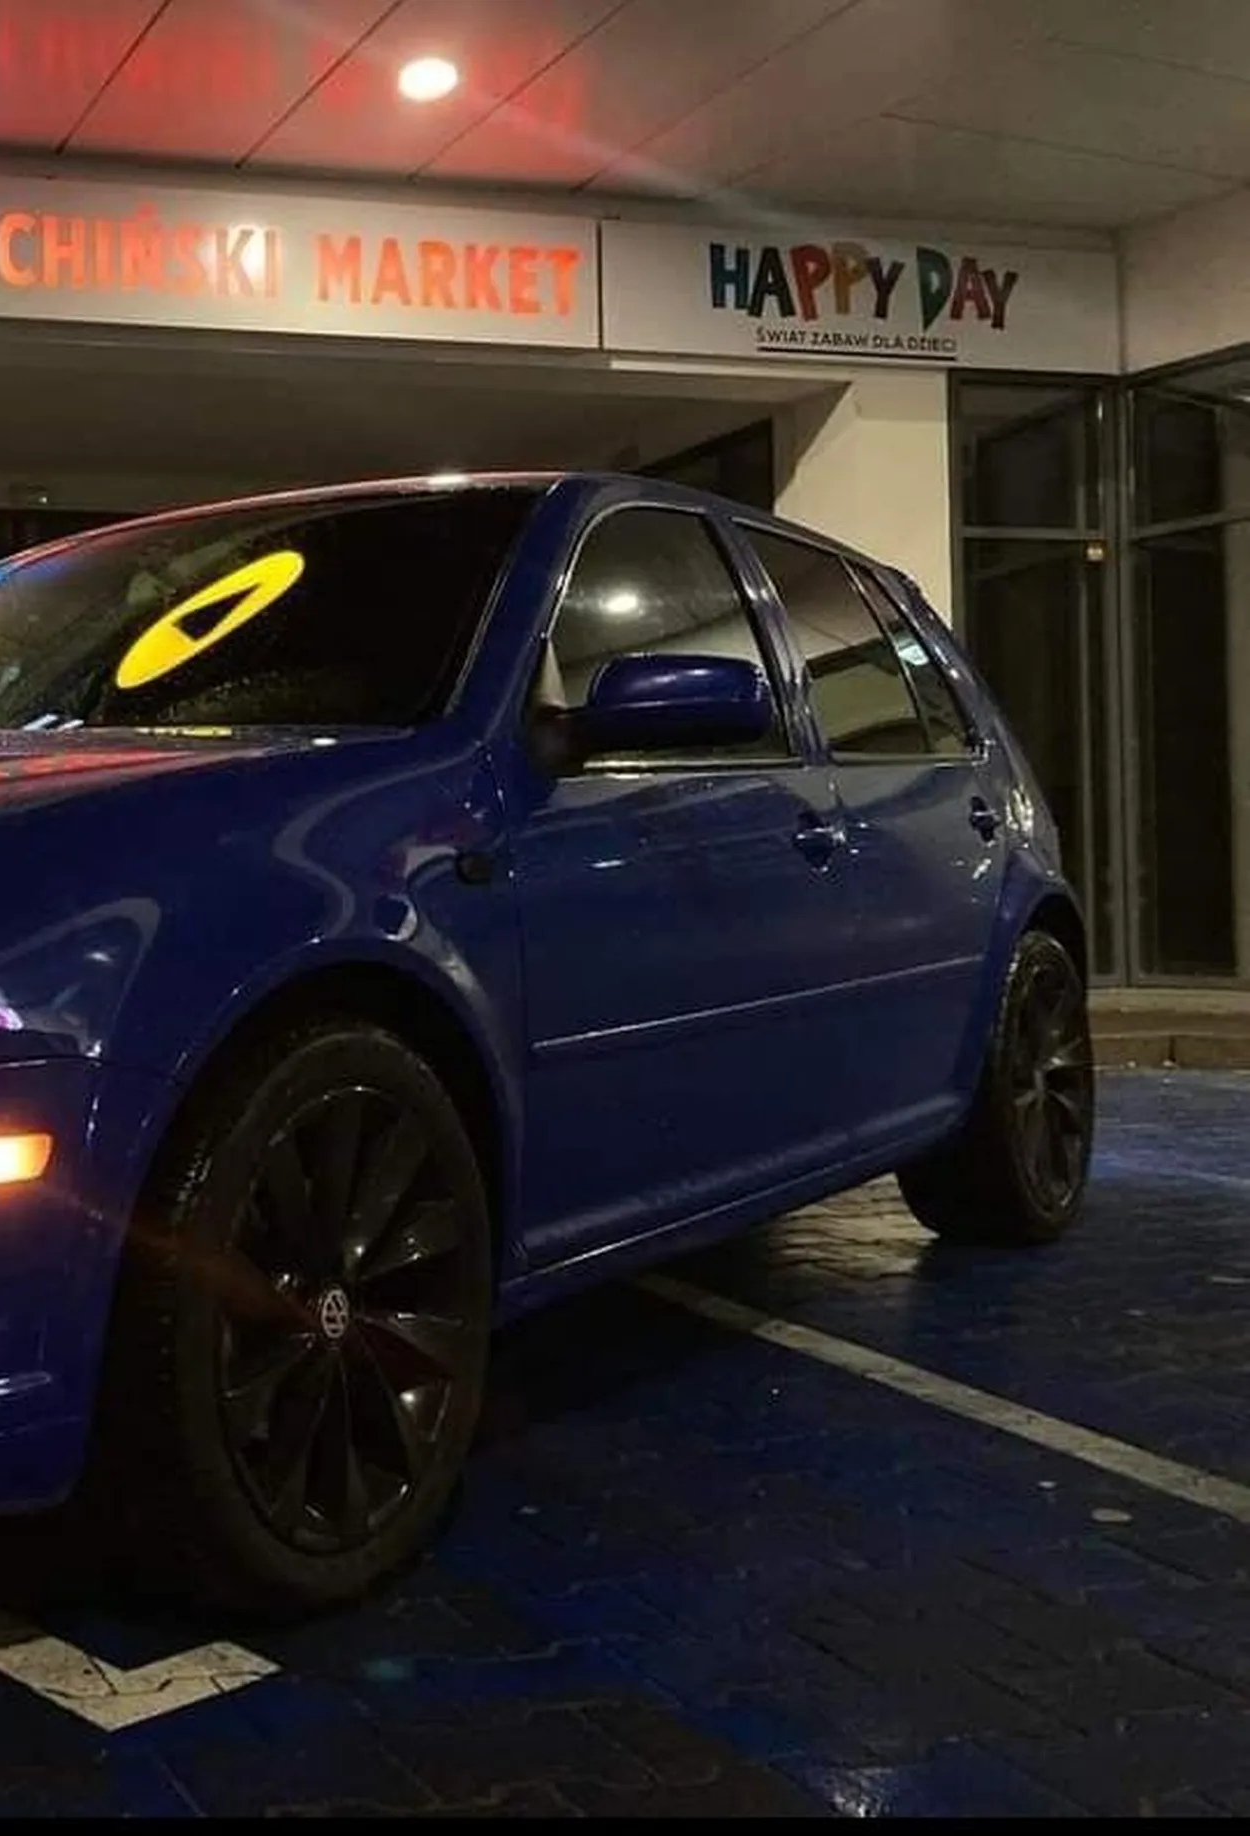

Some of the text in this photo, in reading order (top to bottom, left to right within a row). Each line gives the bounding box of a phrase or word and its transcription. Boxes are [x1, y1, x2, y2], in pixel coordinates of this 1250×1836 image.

[315, 232, 585, 317] MARKET
[709, 241, 1021, 332] HAPPY DAY
[756, 325, 958, 354] ŚWIAT ZABAW DLA DZIECI
